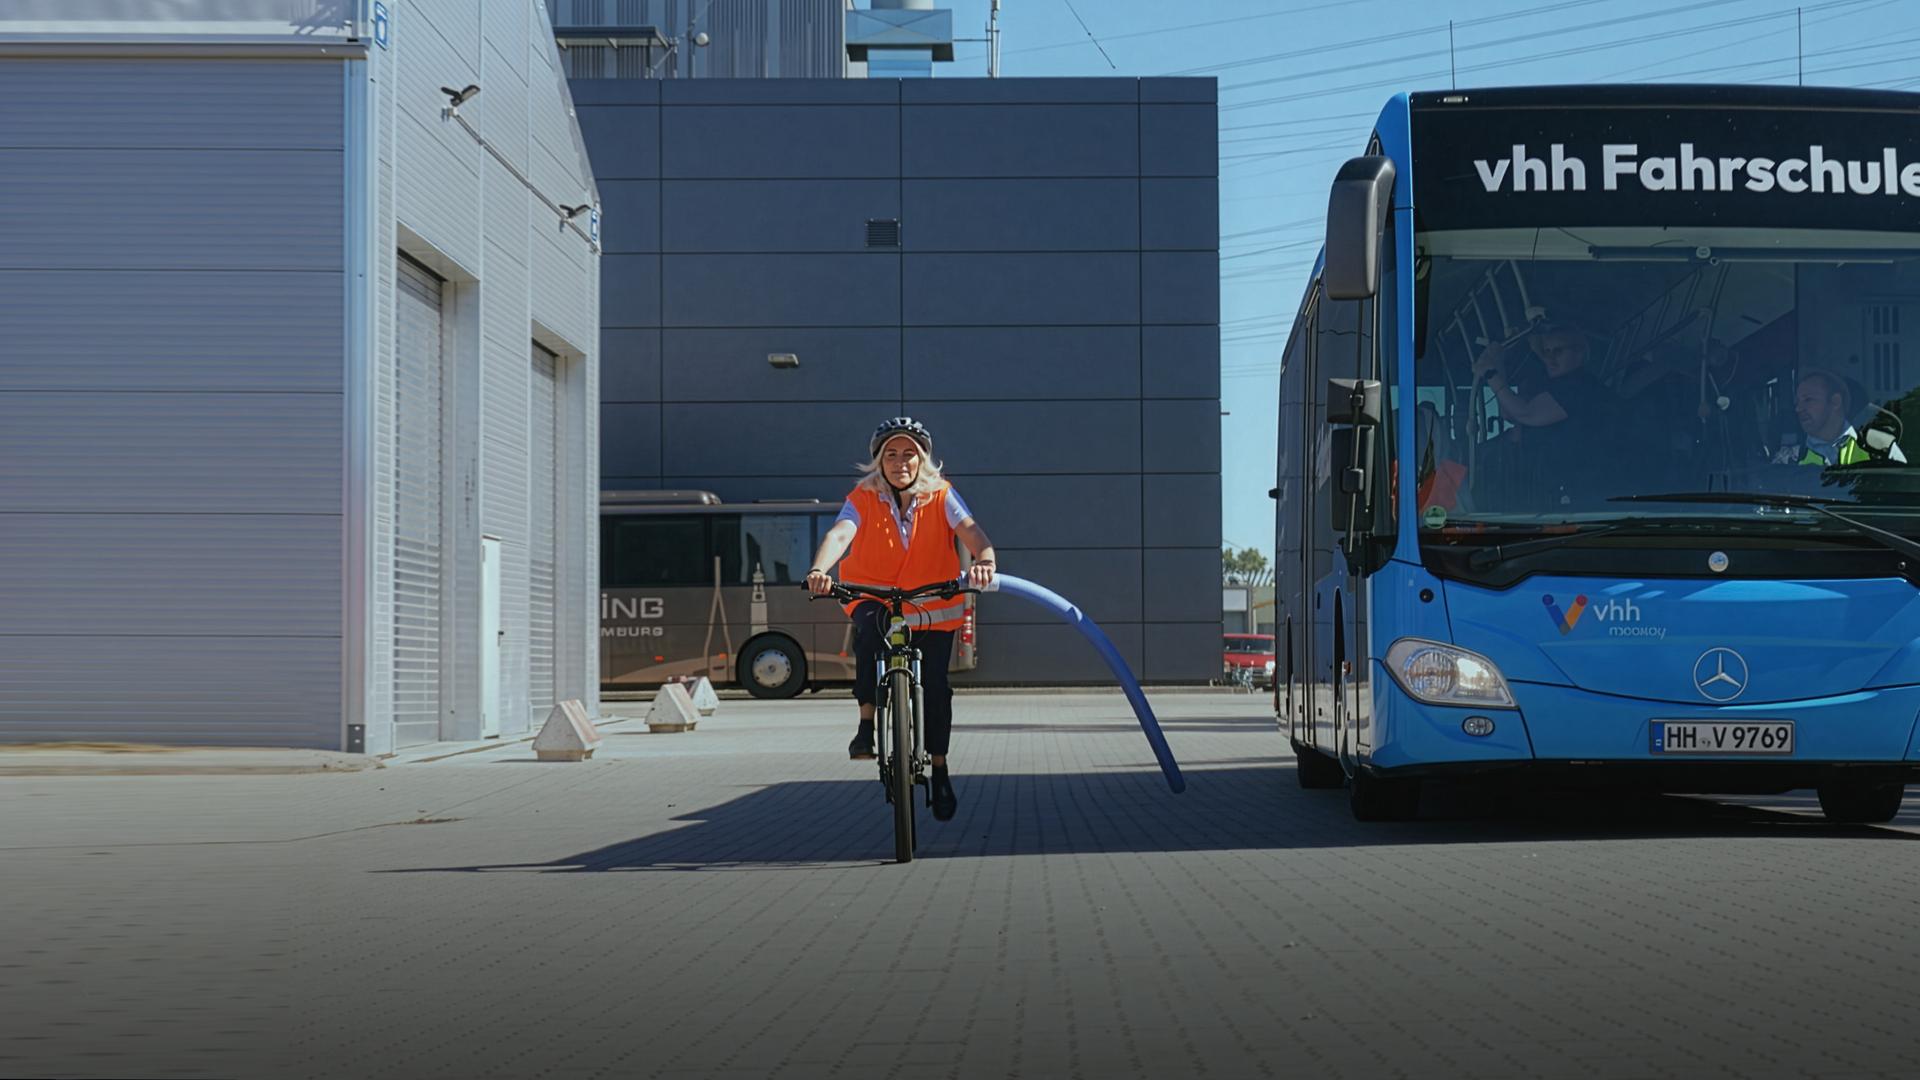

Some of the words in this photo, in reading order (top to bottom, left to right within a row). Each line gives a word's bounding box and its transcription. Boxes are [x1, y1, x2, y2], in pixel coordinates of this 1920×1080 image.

[1473, 143, 1587, 193] vhh
[1602, 143, 1920, 198] Fahrschule
[1593, 598, 1641, 621] vhh
[1666, 726, 1697, 748] HH
[1712, 726, 1727, 749] V
[1732, 726, 1789, 749] 9769
